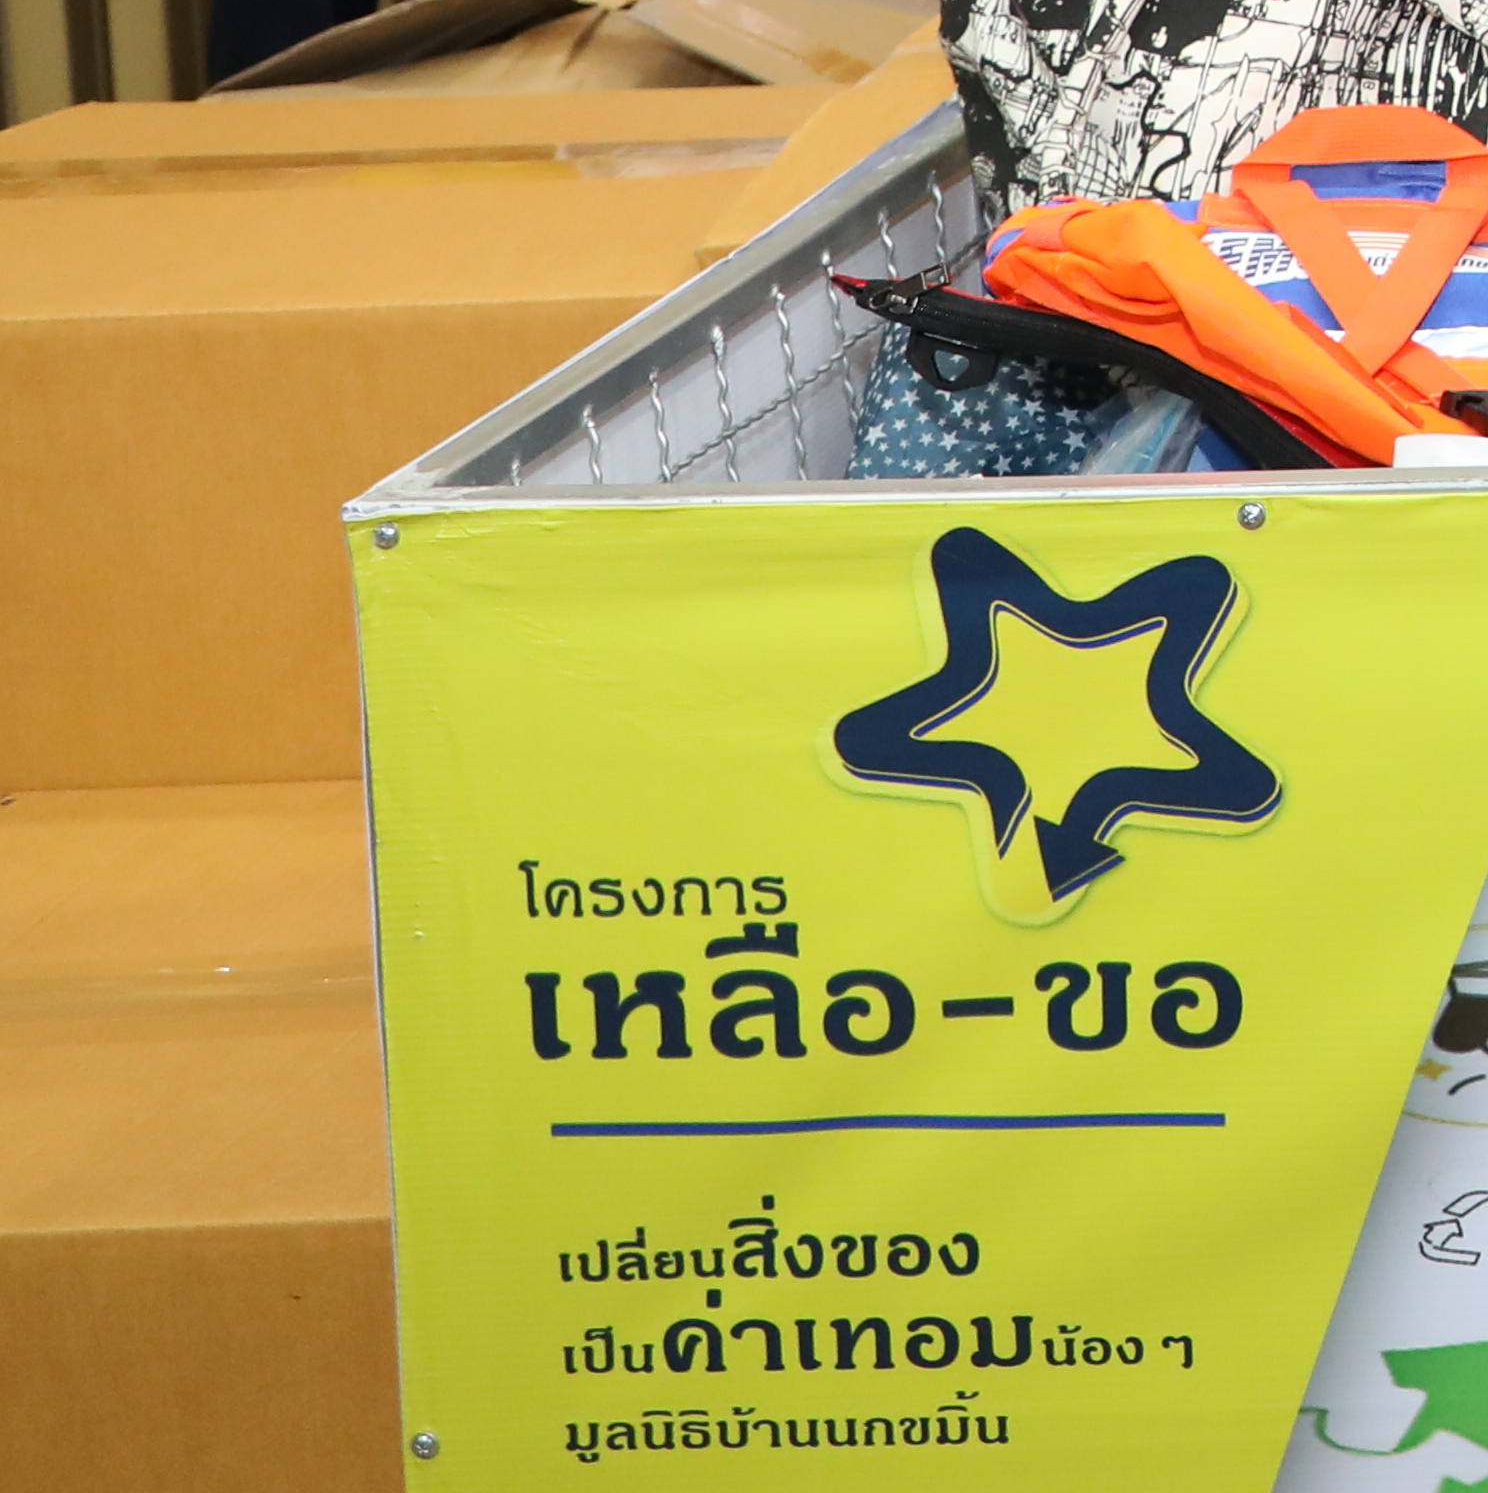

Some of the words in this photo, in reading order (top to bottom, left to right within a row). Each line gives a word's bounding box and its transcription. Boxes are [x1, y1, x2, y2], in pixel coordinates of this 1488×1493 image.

[518, 860, 788, 919] โครงการ
[559, 1194, 981, 1285] เปลี่ยนสิ่งของ
[565, 1390, 1010, 1466] มูลนิธิบ้านนกขมิ้น
